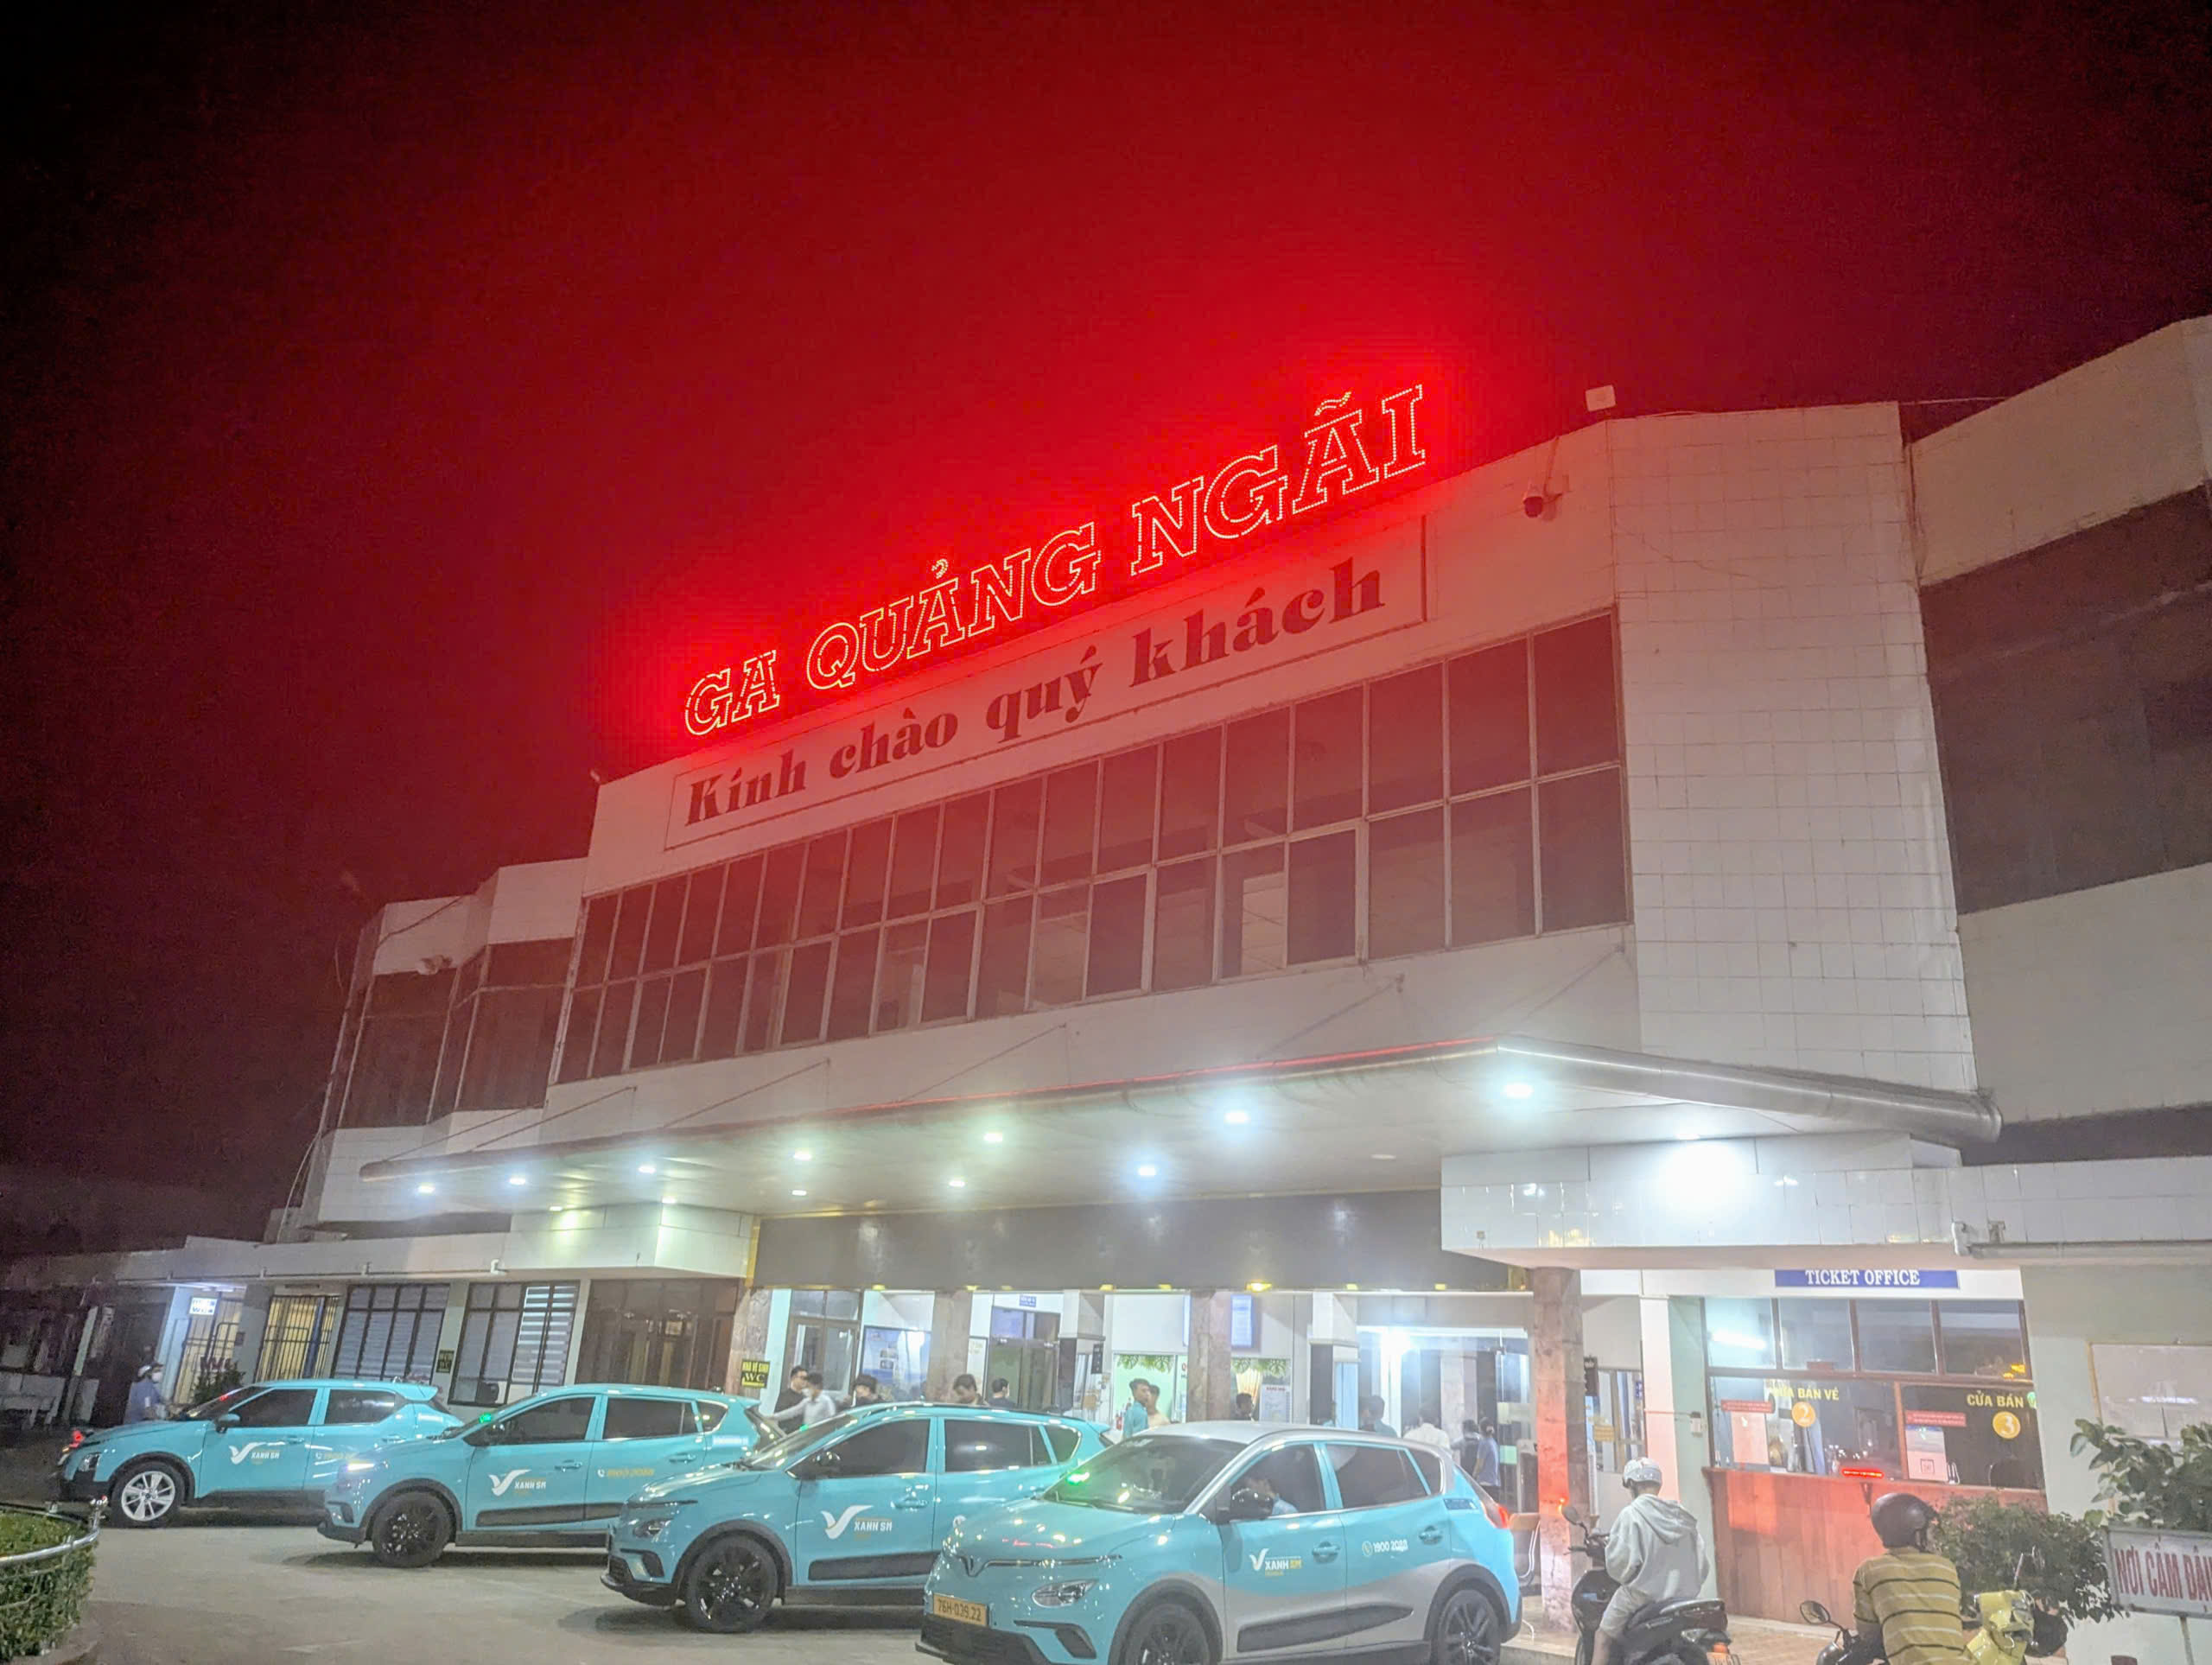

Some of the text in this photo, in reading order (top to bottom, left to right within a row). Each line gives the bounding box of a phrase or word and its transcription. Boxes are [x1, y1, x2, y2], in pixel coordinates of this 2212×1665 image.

[685, 384, 1427, 735] GA QUẢNG NGÃI
[685, 558, 1385, 826] Kính chào quý khách
[1805, 1269, 1920, 1286] TICKET OFFICE
[1967, 1390, 1993, 1408] CỬA
[1996, 1393, 2024, 1408] BÁN
[854, 1521, 893, 1532] XANH SM
[1265, 1559, 1289, 1570] XANH
[2114, 1544, 2145, 1596] NƠI
